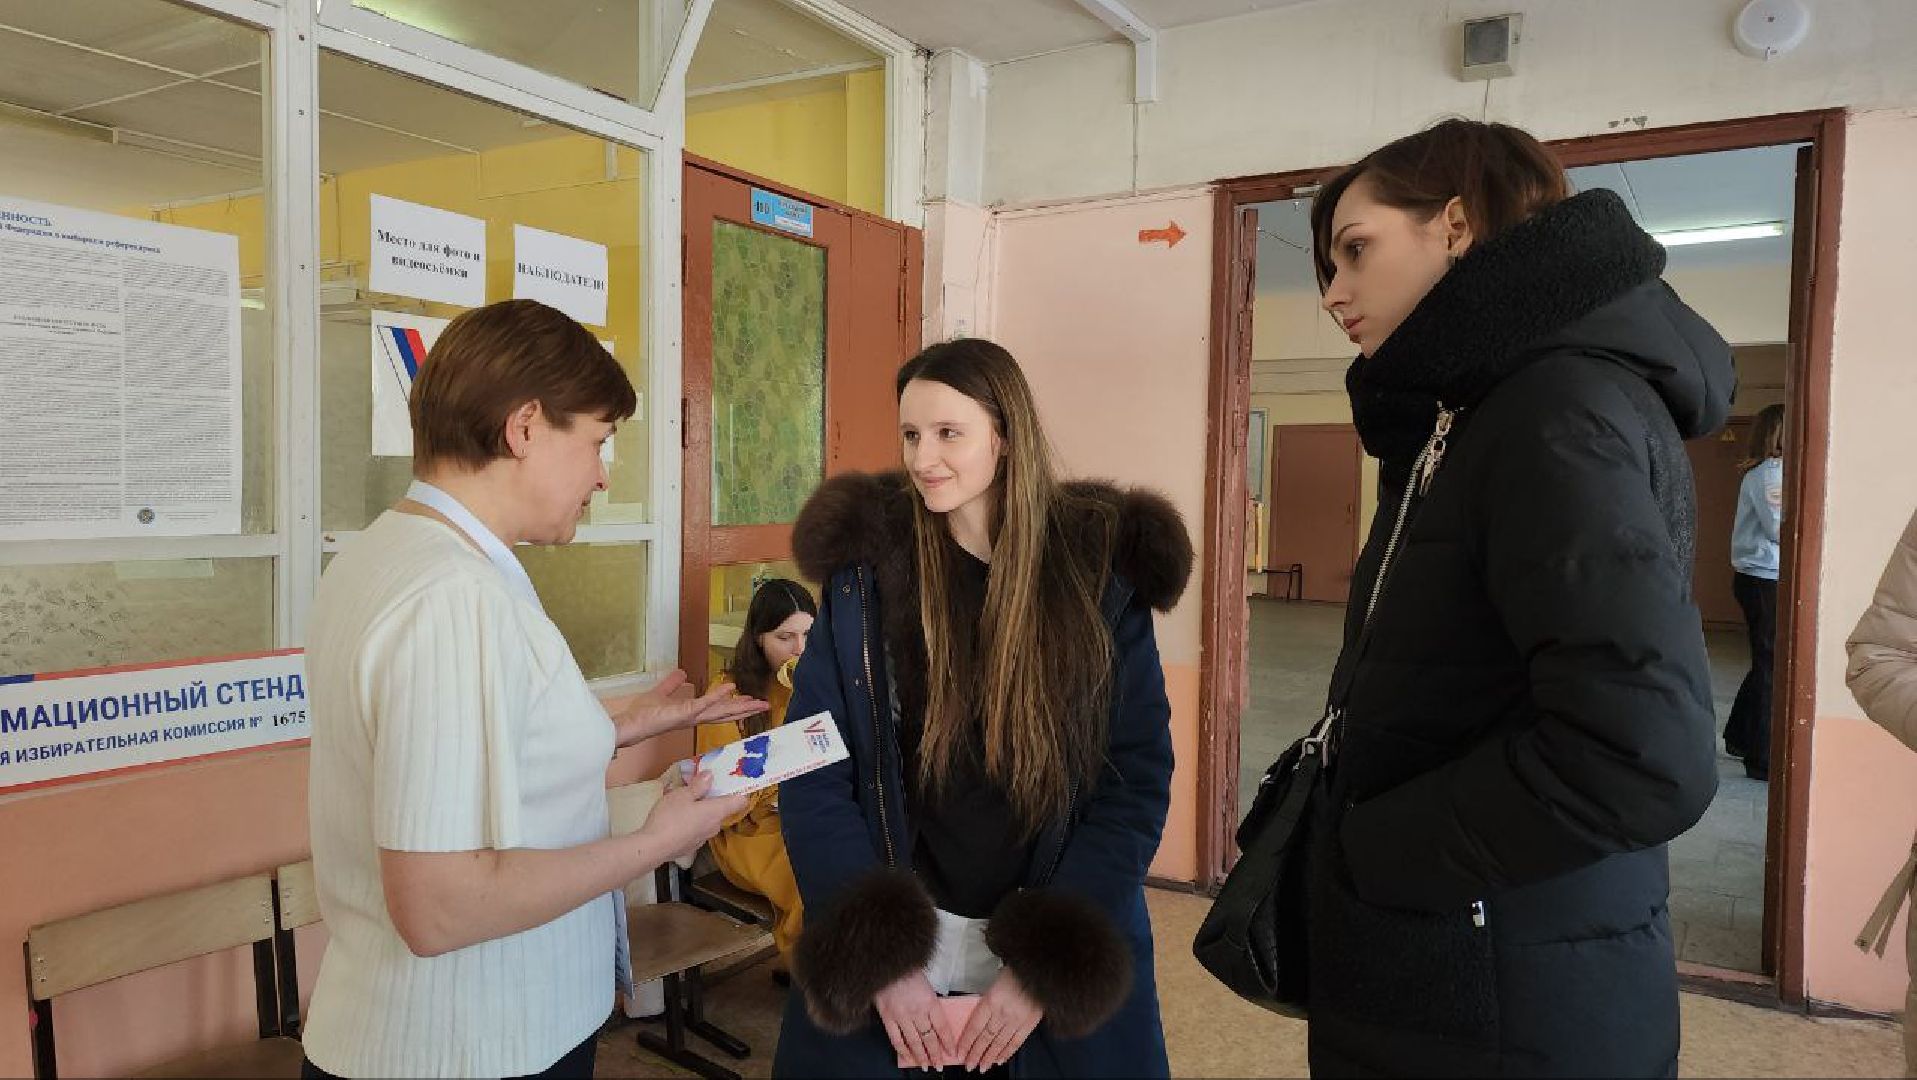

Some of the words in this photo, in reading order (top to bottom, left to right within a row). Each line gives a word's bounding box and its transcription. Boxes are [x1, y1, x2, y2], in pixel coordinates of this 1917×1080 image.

[0, 211, 52, 226] ННОСТЬ
[378, 229, 416, 248] Место
[419, 241, 440, 254] для
[443, 244, 471, 258] фото
[474, 253, 480, 261] и
[0, 681, 208, 733] МАЦИОННЫЙ
[216, 674, 305, 705] СТЕНД
[16, 730, 158, 764] ИЗБИРАТЕЛЬНАЯ
[163, 718, 245, 740] КОМИССИЯ
[272, 710, 306, 727] 1675
